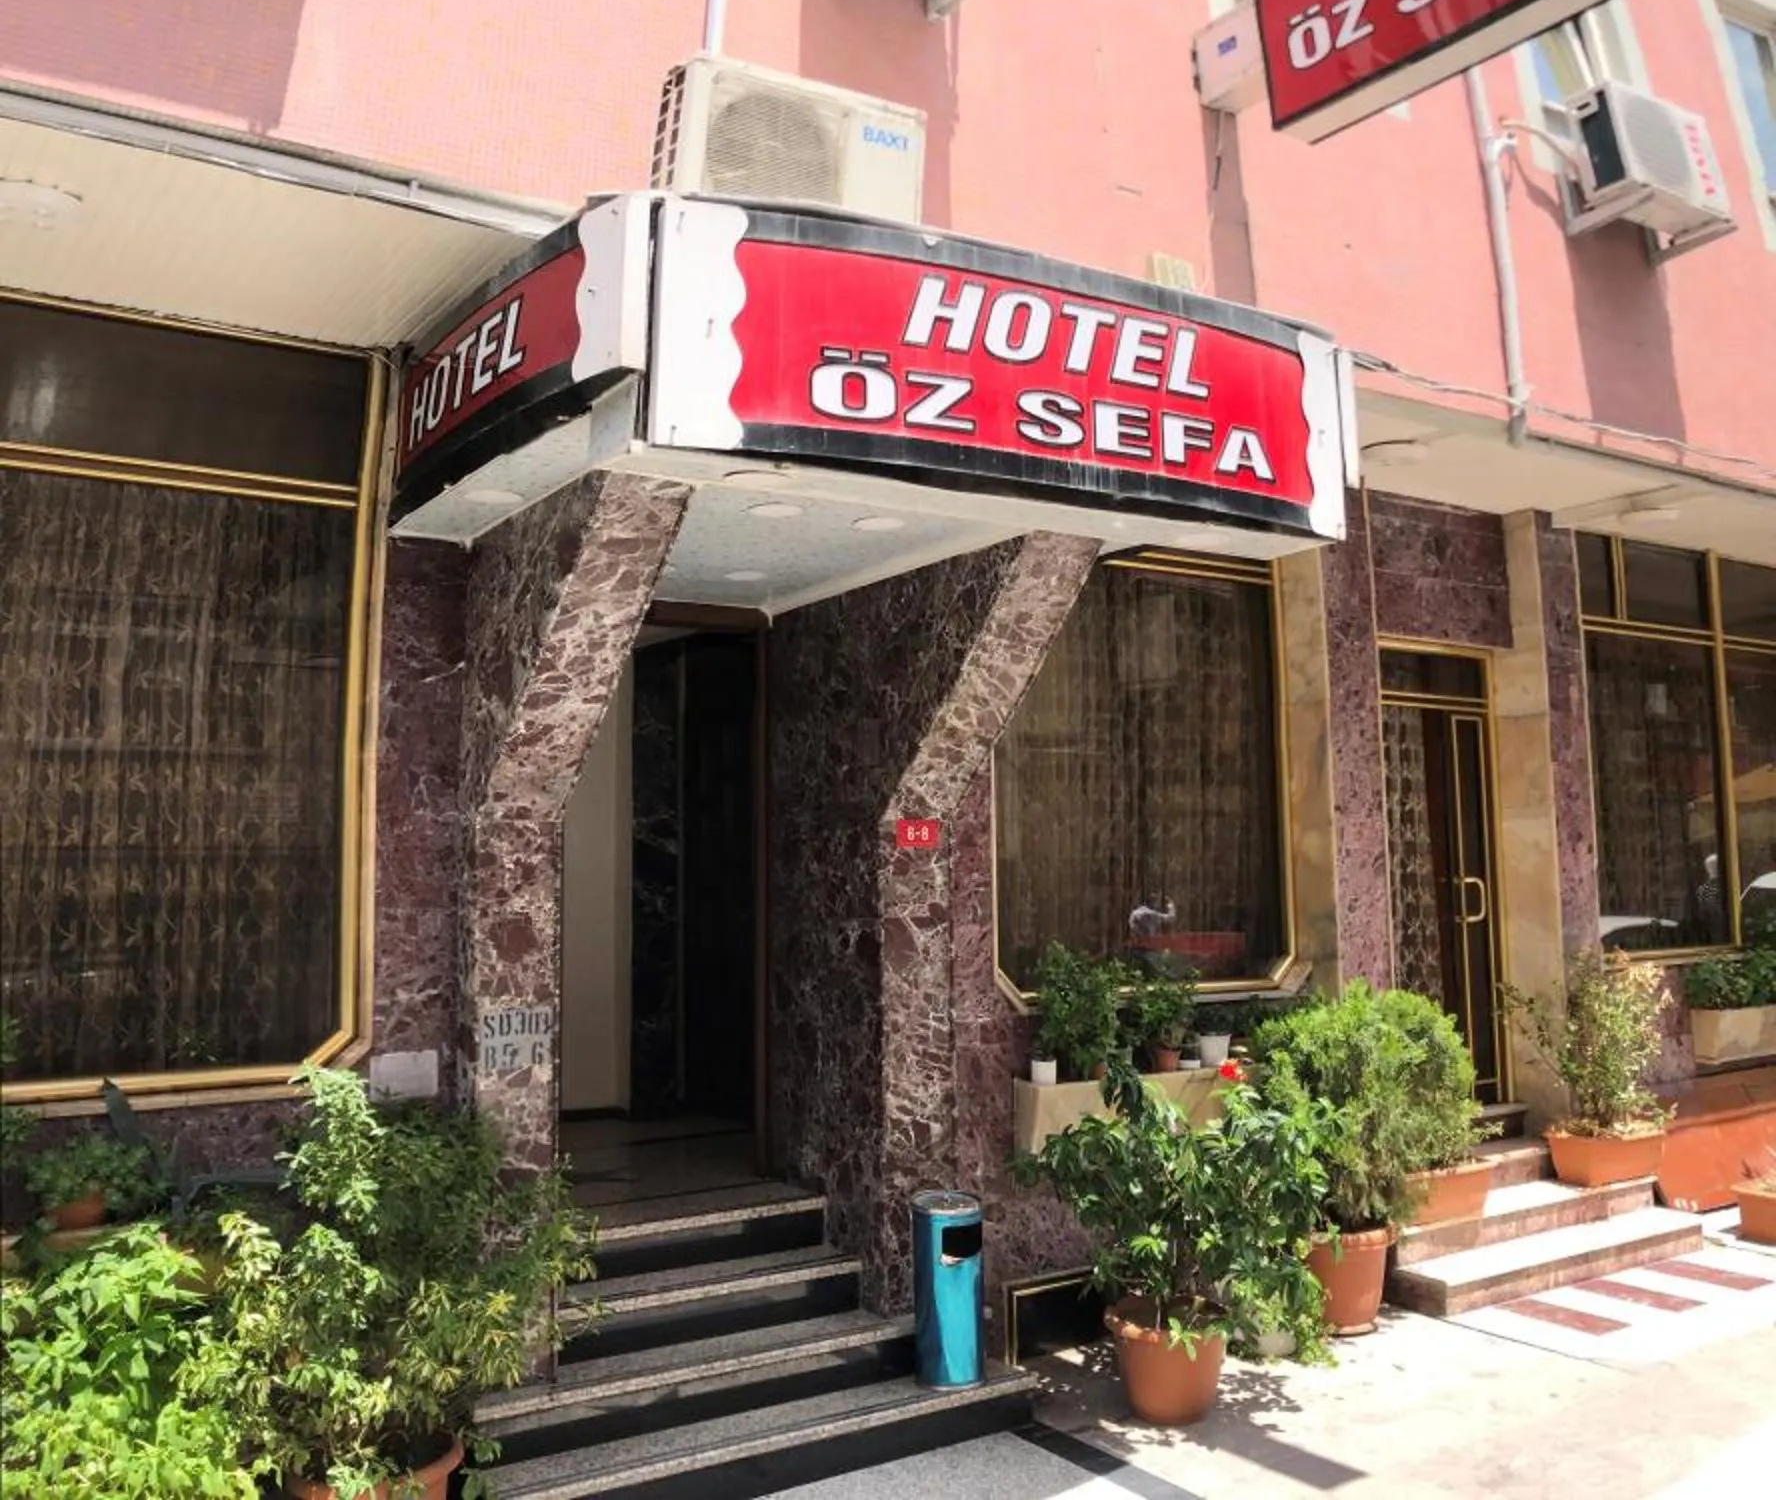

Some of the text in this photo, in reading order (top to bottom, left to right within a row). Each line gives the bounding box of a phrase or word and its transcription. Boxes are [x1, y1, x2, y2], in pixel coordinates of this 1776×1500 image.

[863, 125, 908, 151] BAXI
[408, 298, 525, 451] HOTEL
[901, 274, 1212, 399] HOTEL
[809, 347, 1277, 483] ÖZ SEFA
